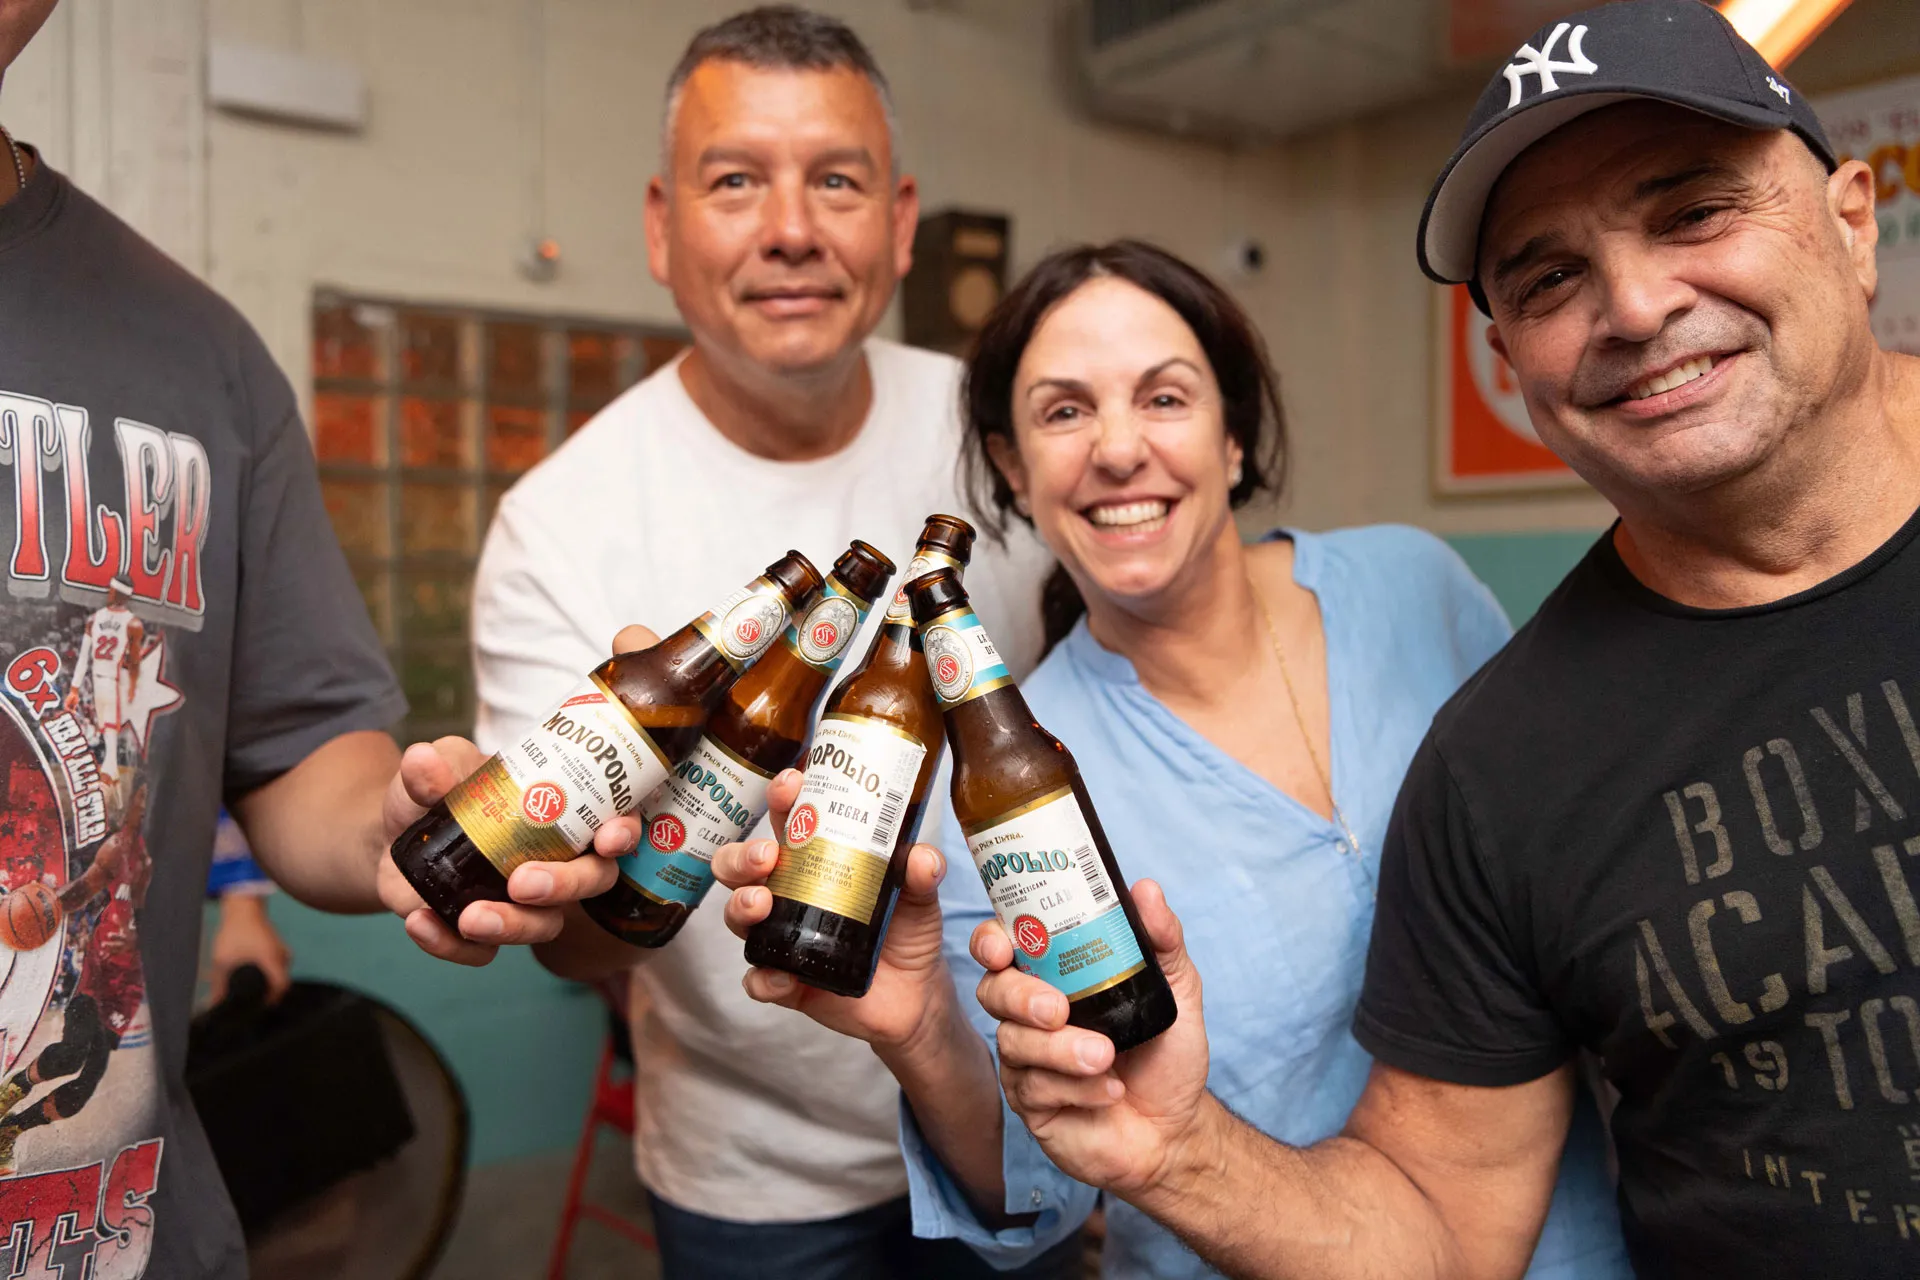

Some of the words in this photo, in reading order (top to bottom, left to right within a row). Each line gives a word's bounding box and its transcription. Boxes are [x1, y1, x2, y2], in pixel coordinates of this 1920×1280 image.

[94, 635, 119, 661] 22
[44, 712, 89, 758] NBA
[521, 738, 548, 769] LAGER
[64, 750, 101, 794] ALL
[76, 789, 107, 844] STAR
[828, 801, 869, 824] NEGRA
[1710, 1040, 1789, 1092] 19
